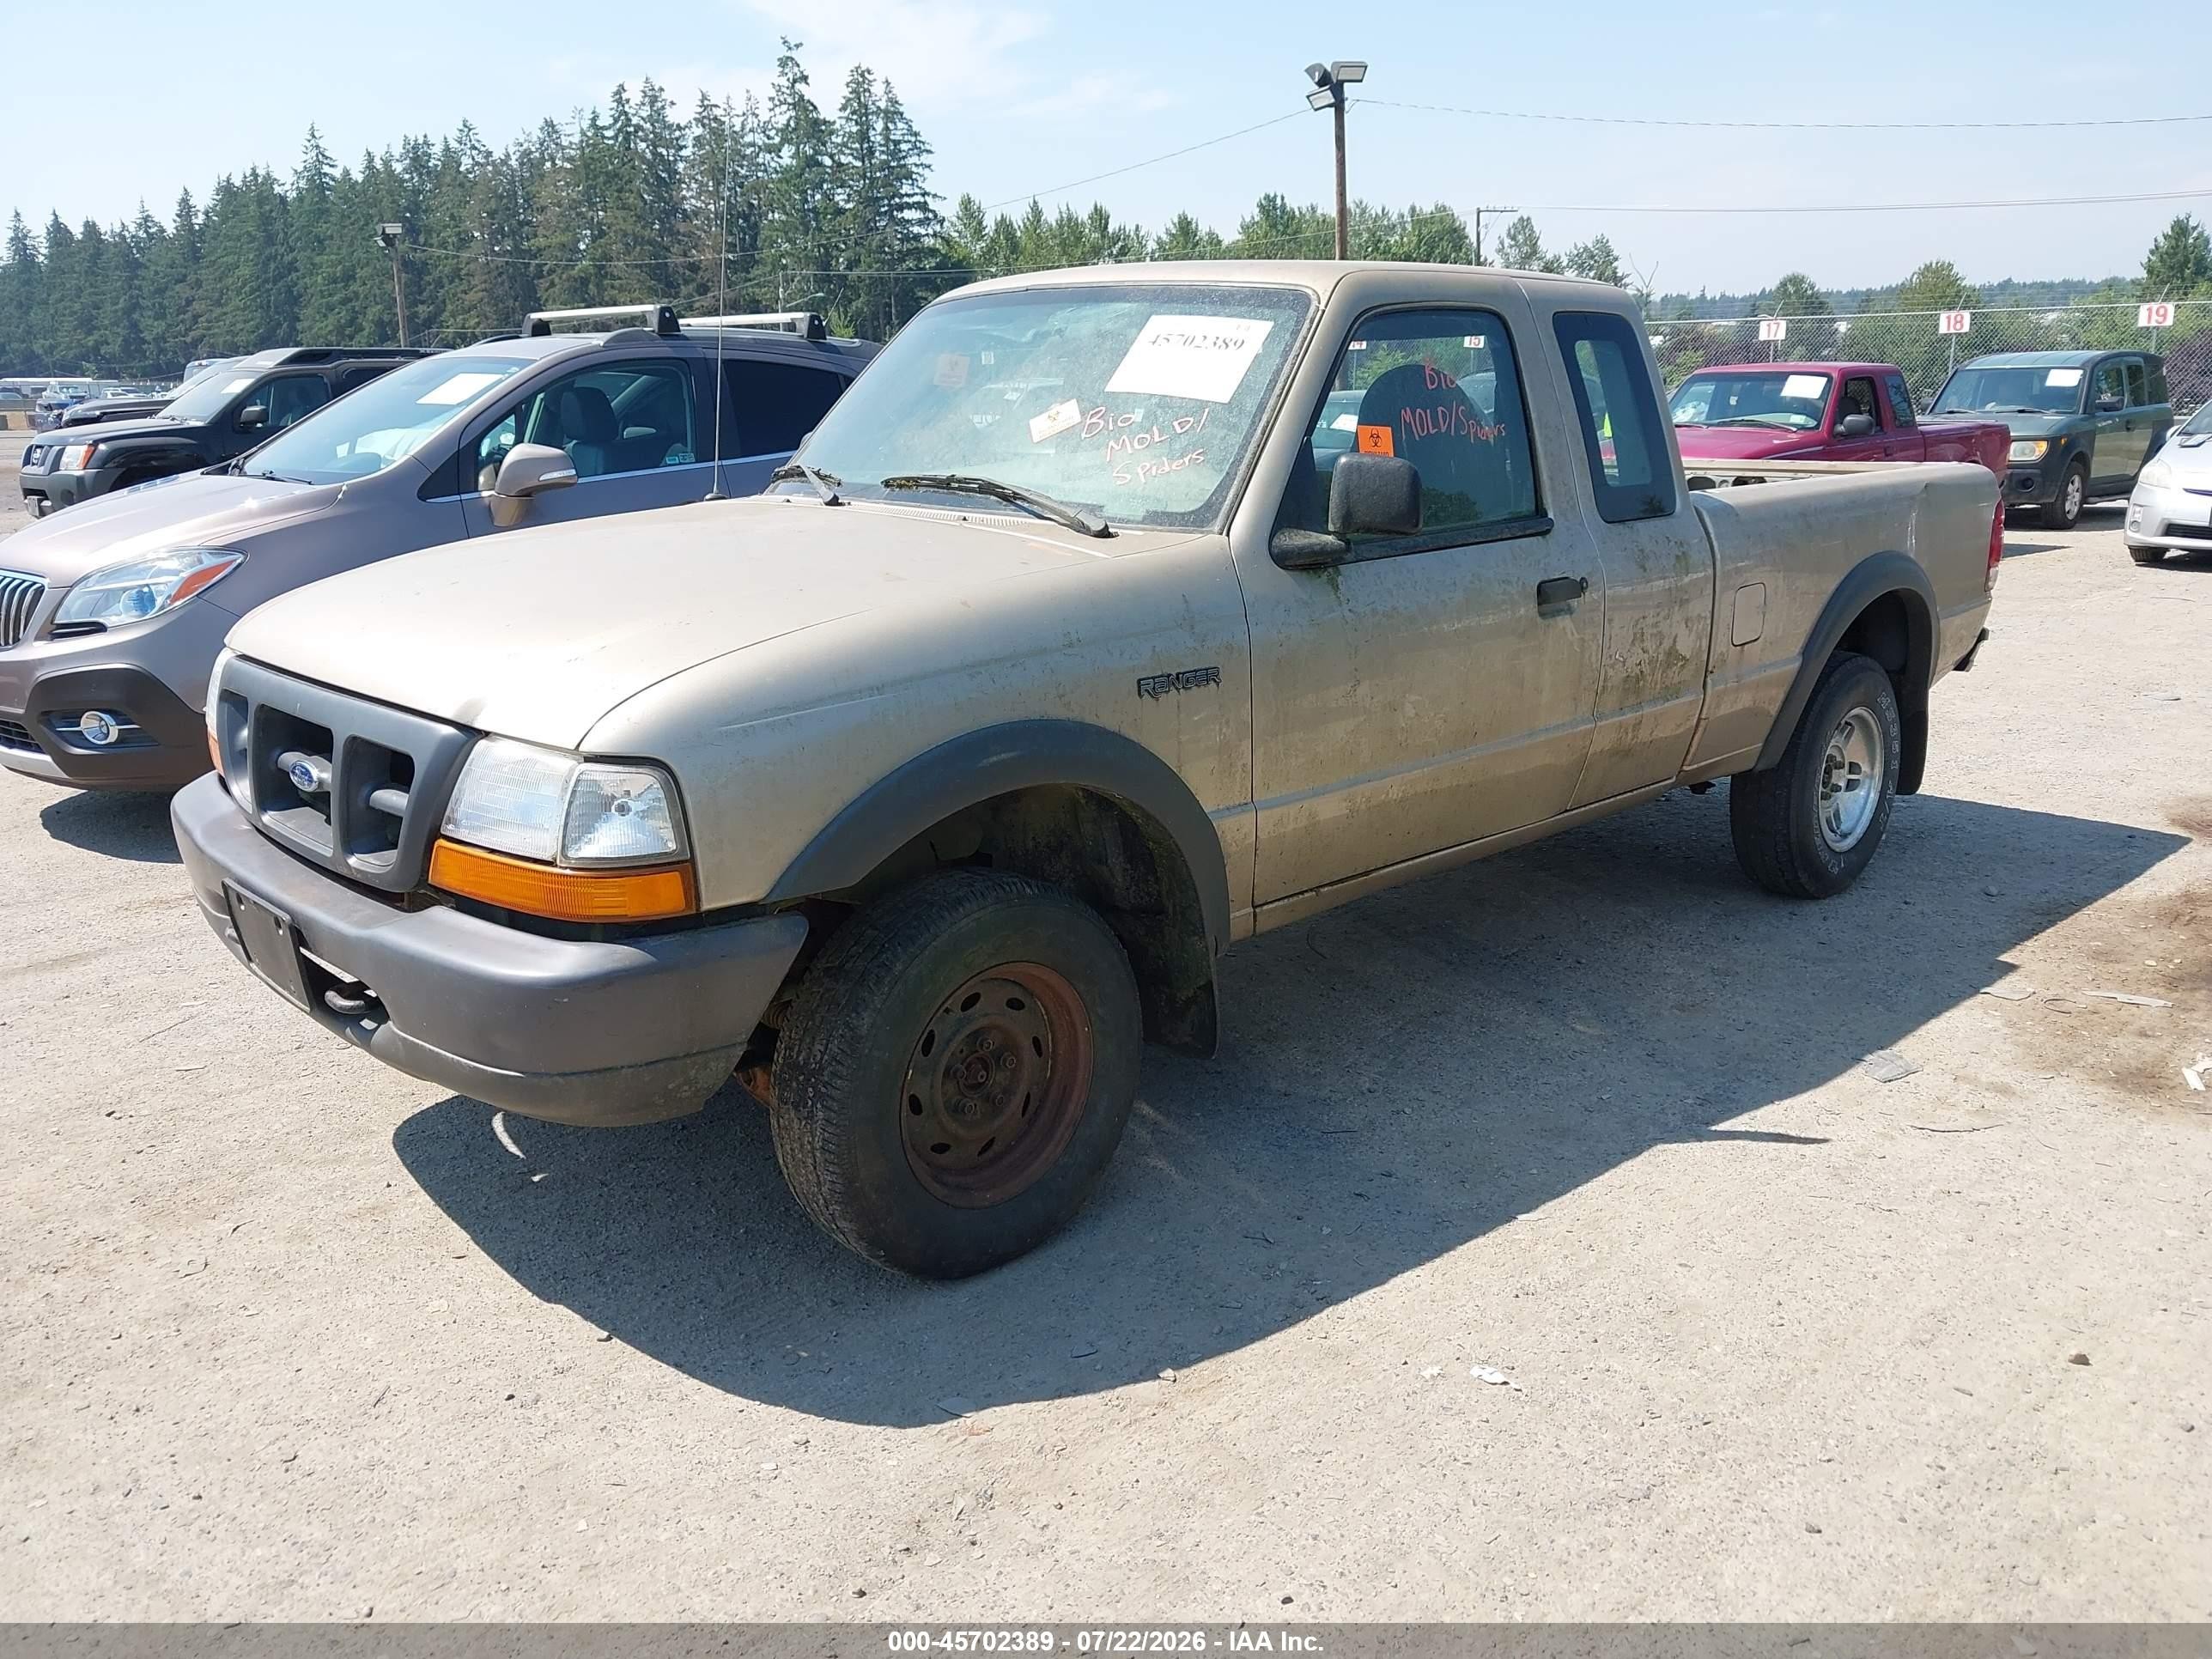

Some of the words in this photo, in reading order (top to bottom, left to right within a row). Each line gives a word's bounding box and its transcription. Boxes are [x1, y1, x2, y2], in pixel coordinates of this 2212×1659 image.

[1945, 313, 1965, 332] 18
[2146, 304, 2168, 325] 19
[1765, 321, 1781, 339] 17
[1148, 332, 1246, 351] 45702389
[1081, 405, 1137, 441] Bio
